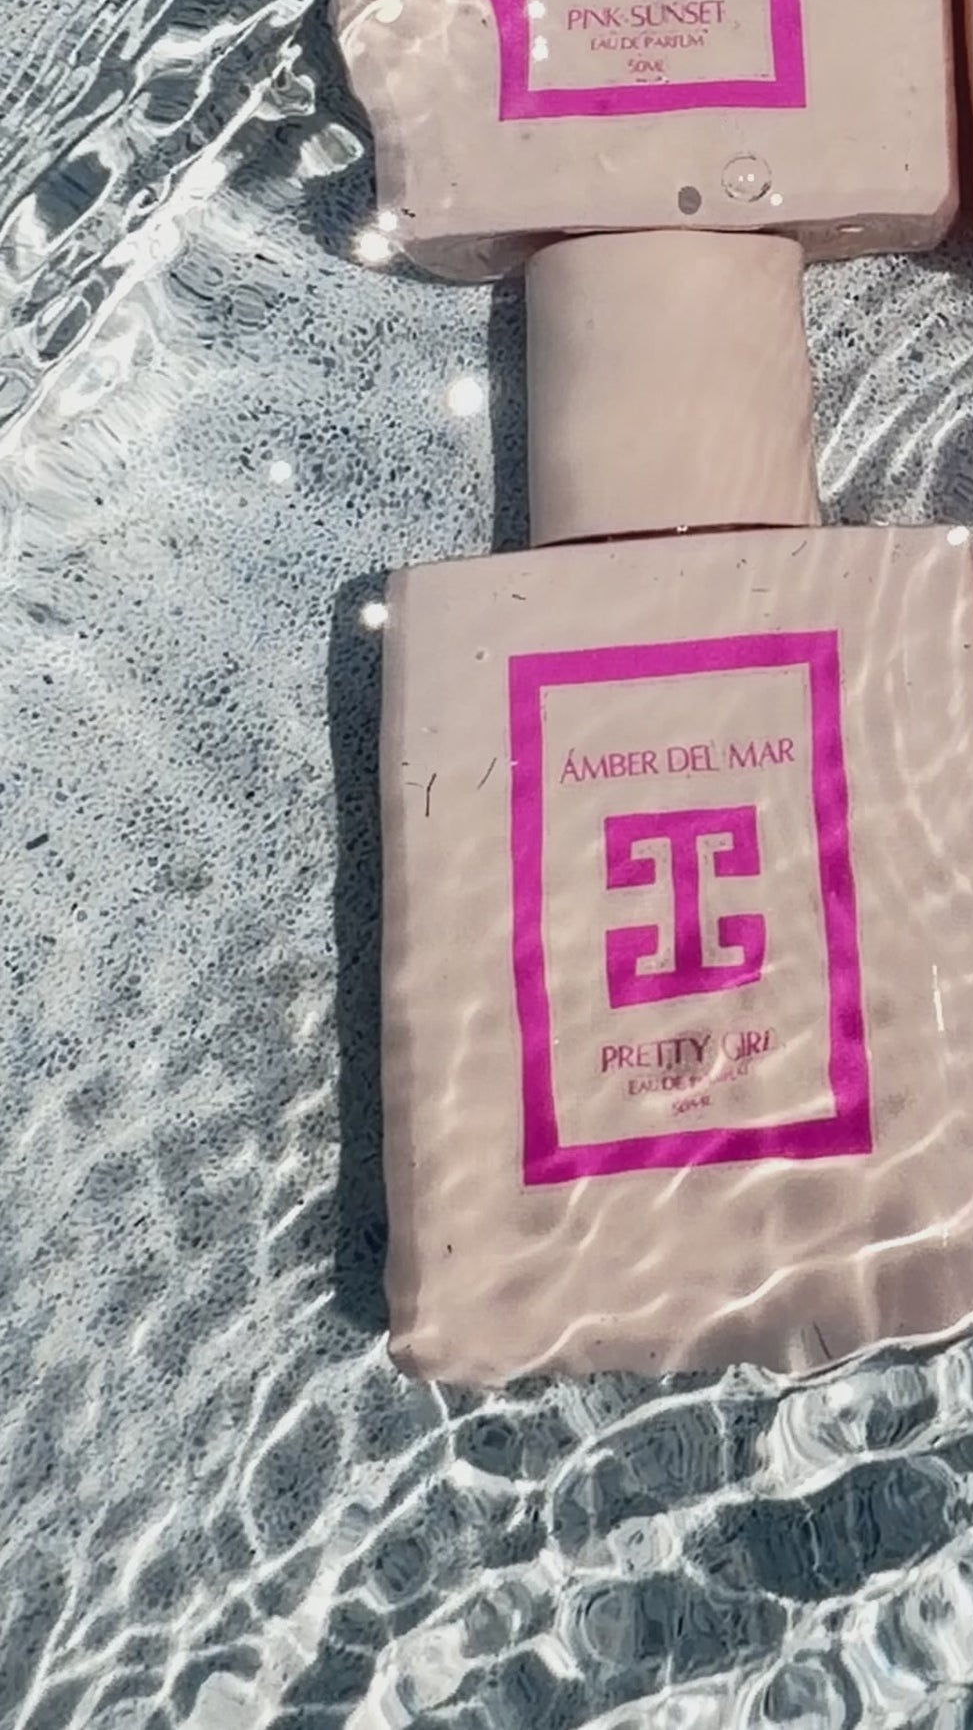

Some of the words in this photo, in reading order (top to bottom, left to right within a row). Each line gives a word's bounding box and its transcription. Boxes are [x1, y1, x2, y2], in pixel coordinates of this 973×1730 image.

[567, 7, 621, 30] PINK
[630, 0, 725, 28] SUNSET
[560, 748, 660, 784] ÁMBER
[667, 744, 720, 773] DEL
[728, 737, 795, 770] MAR
[602, 1032, 712, 1073] PRETTY
